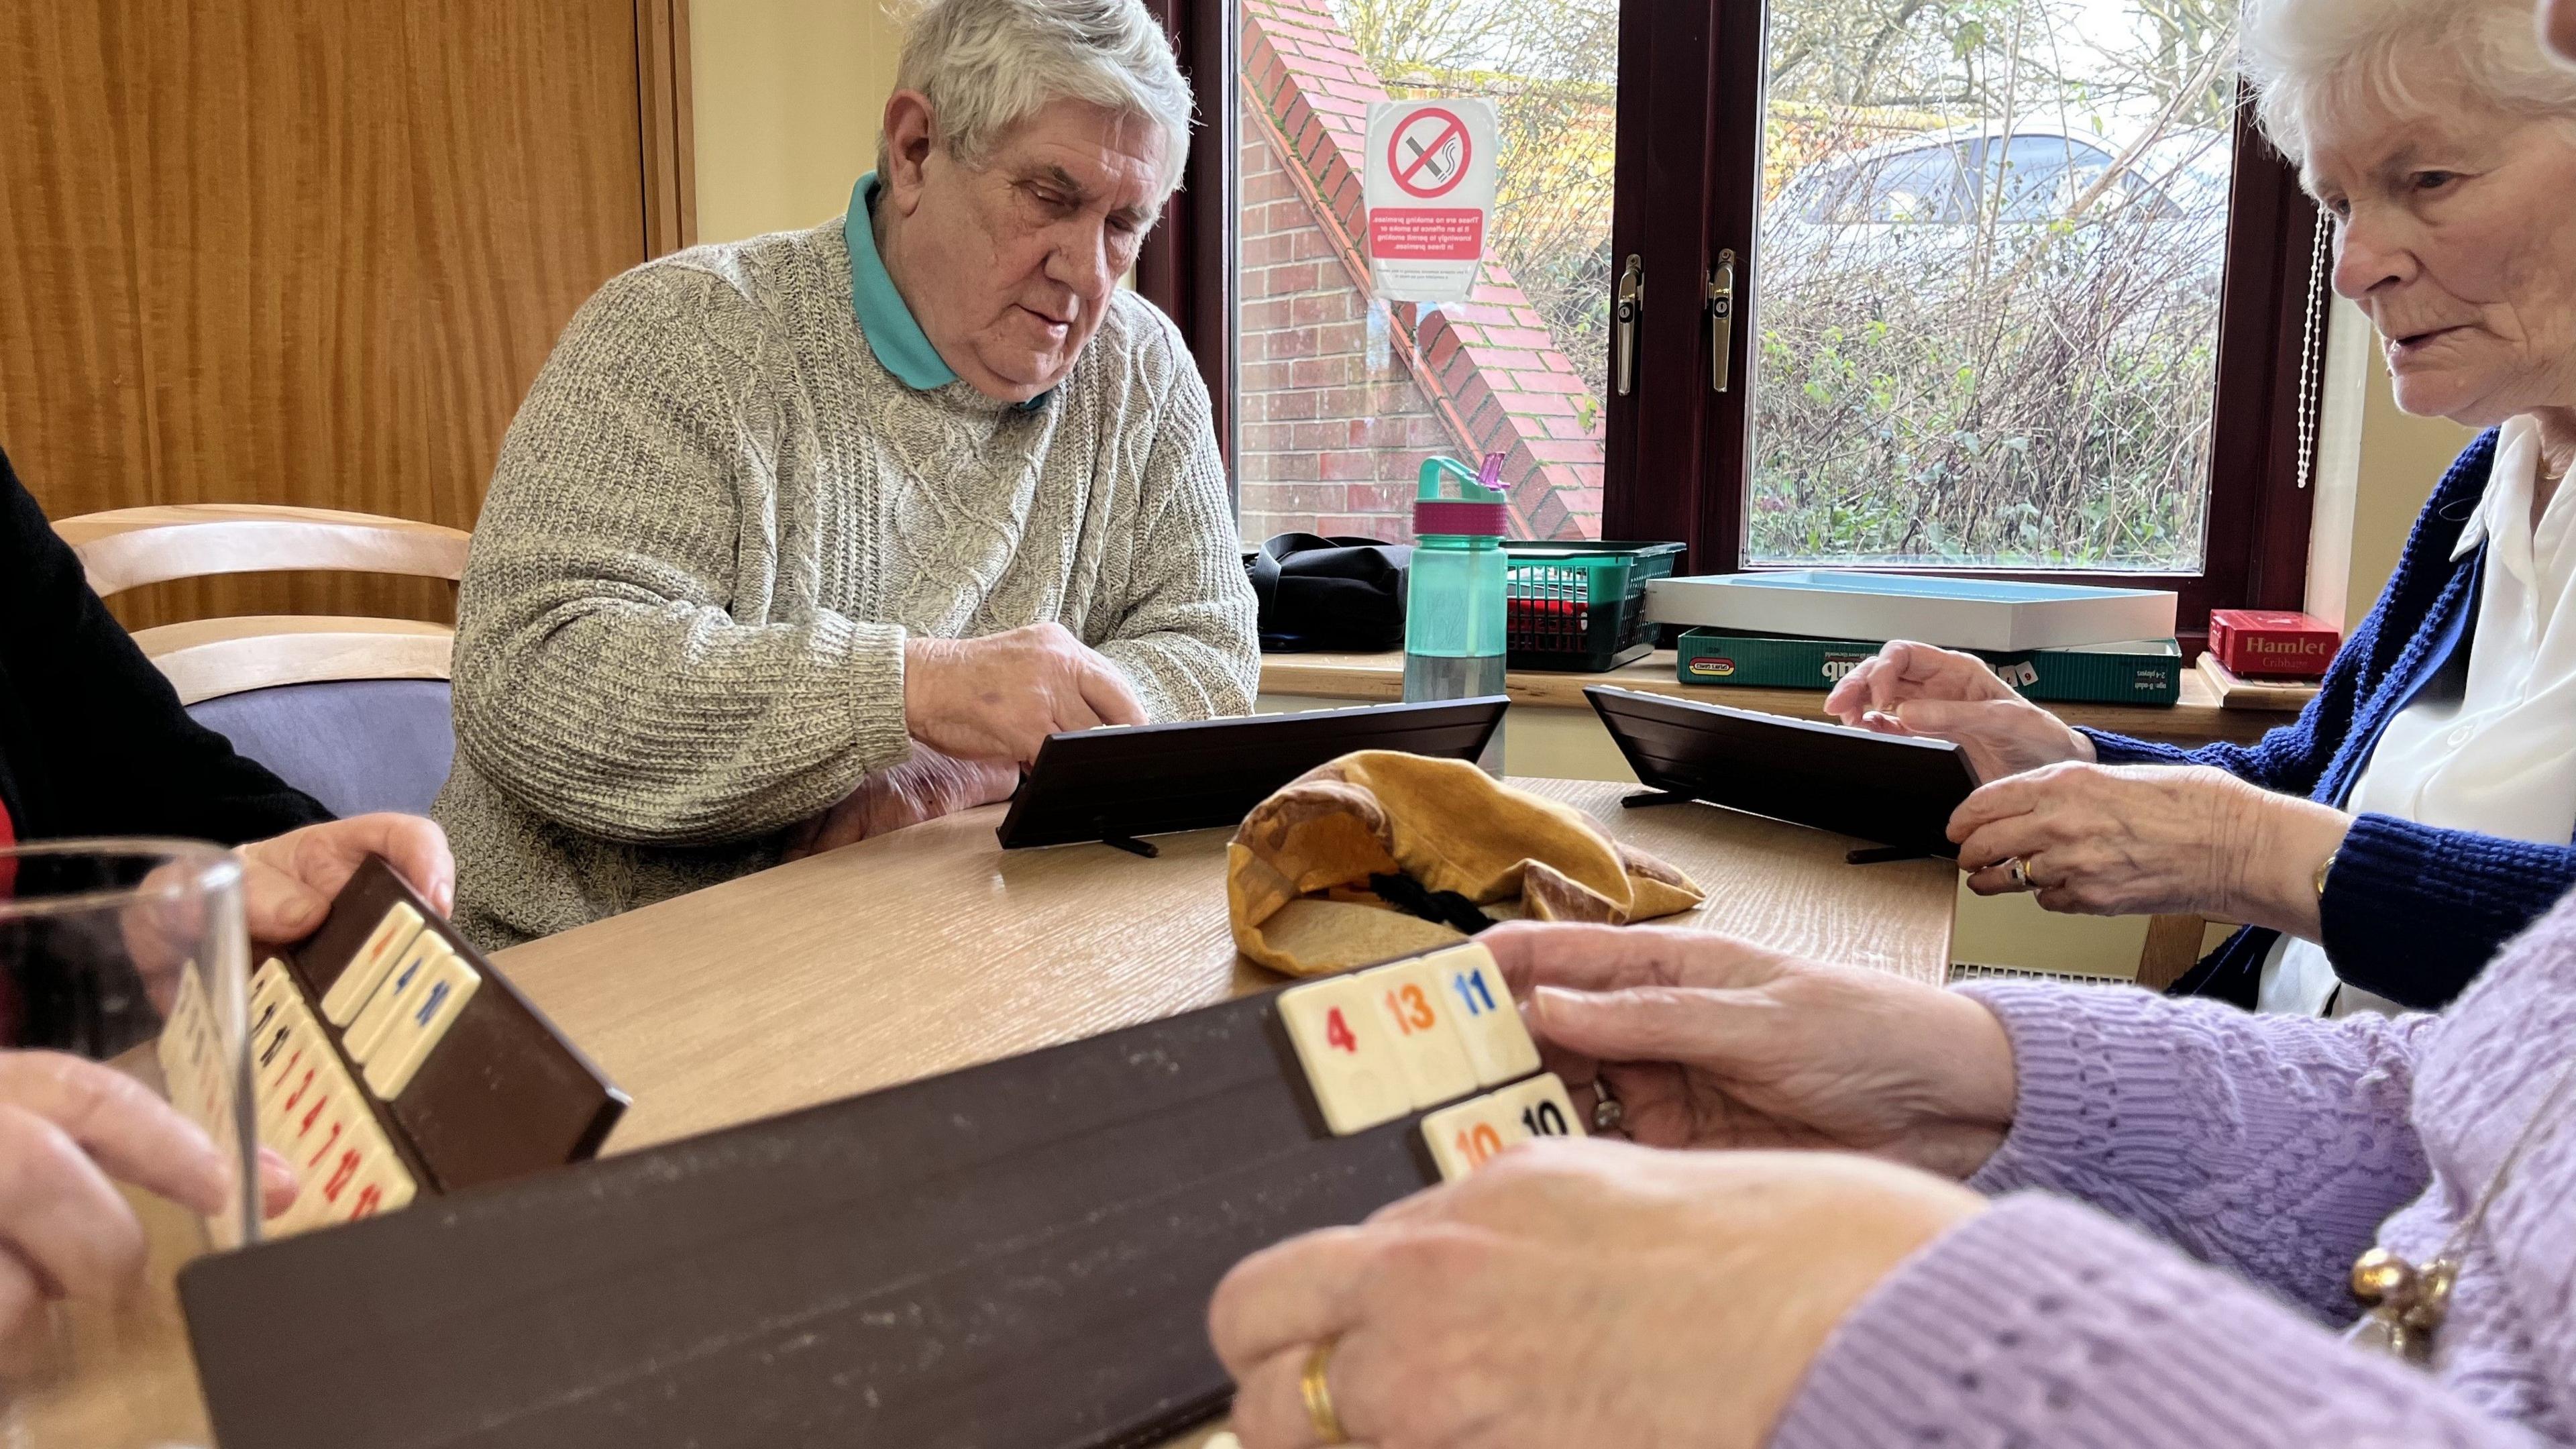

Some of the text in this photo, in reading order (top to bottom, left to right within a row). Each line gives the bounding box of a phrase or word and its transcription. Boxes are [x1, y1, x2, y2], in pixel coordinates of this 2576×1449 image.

[2246, 637, 2326, 655] Hamlet
[2137, 669, 2155, 678] players
[1326, 968, 1497, 1054] 4 13 11
[299, 1095, 327, 1138] 4
[1456, 1099, 1568, 1169] 10 10
[309, 1121, 341, 1168] 7
